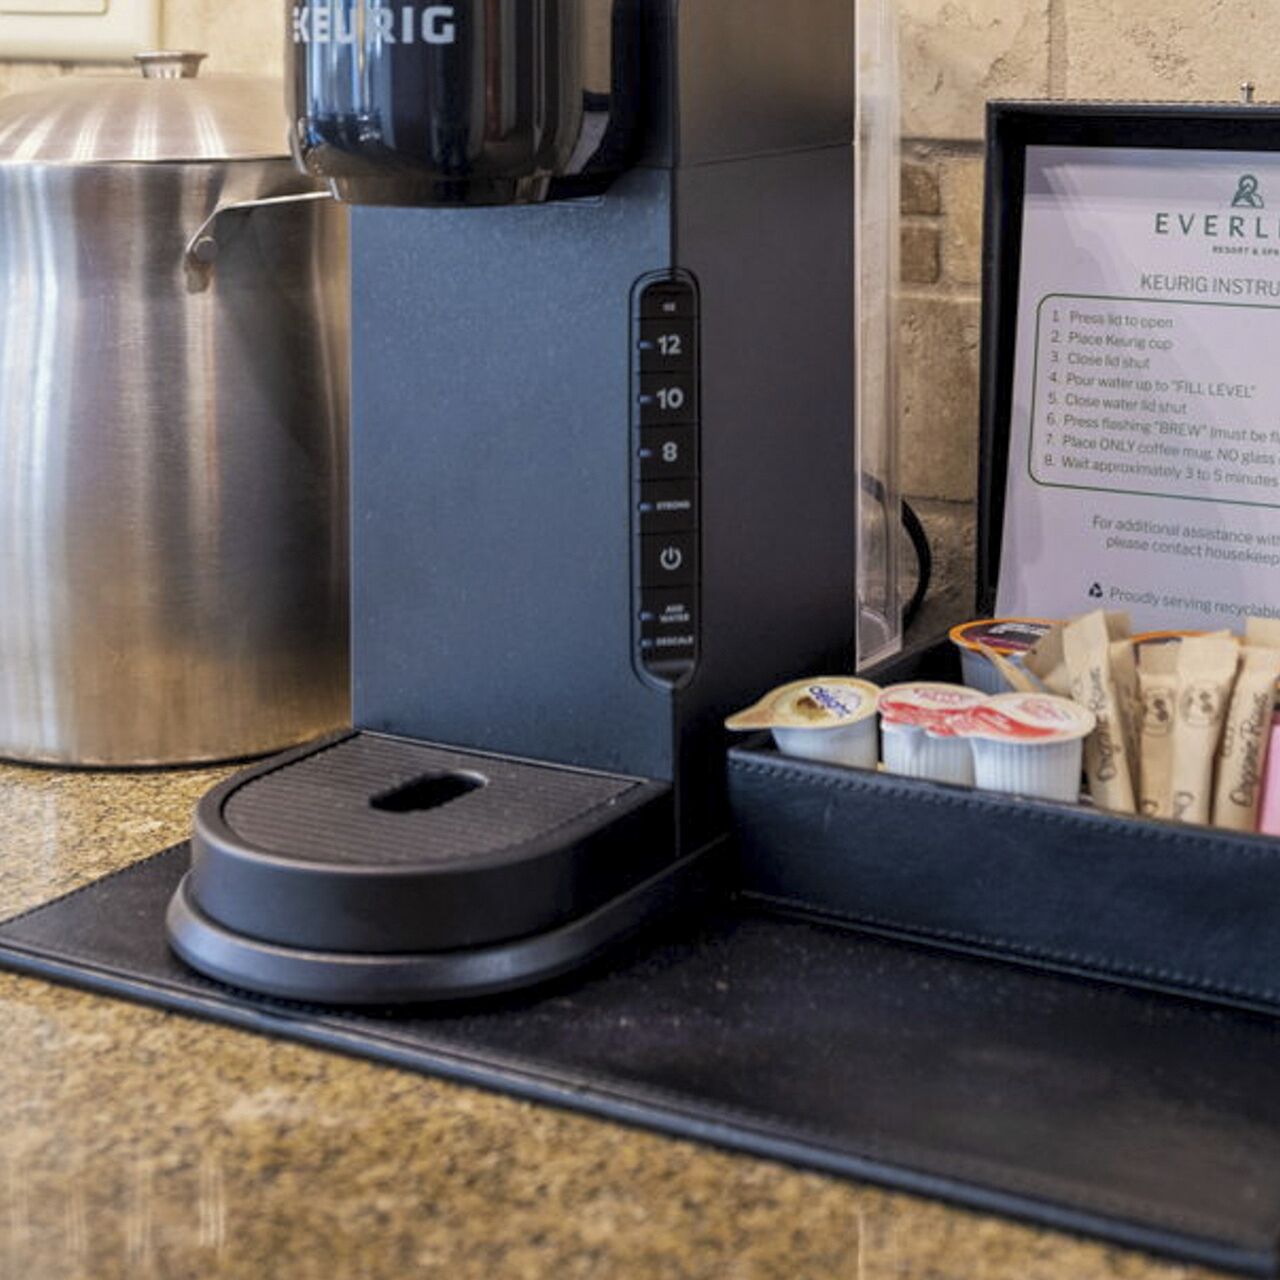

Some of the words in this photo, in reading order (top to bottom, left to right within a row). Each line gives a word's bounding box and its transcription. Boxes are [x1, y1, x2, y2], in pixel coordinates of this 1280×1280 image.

[294, 6, 455, 43] KEURIG
[1212, 246, 1249, 255] RESORT
[1140, 274, 1207, 293] KEURIG
[1070, 310, 1104, 325] Press
[1107, 313, 1121, 326] lid
[1125, 315, 1138, 327] to
[1140, 318, 1173, 329] open
[657, 334, 681, 355] 12
[1069, 331, 1103, 346] Place
[1106, 334, 1146, 351] Keurig
[1149, 339, 1174, 350] cup
[1068, 353, 1103, 367] Close
[1105, 355, 1119, 367] lid
[1122, 357, 1150, 369] shut
[1066, 373, 1094, 386] Pour
[1098, 377, 1133, 389] water
[1135, 381, 1152, 392] up
[1155, 380, 1168, 391] to
[656, 387, 684, 409] 10
[1066, 393, 1100, 407] Close
[1102, 398, 1137, 411] water
[1140, 399, 1155, 412] lid
[1158, 402, 1187, 414] shut
[1064, 414, 1098, 429] Press
[1101, 417, 1151, 435] flashing
[1154, 420, 1207, 438] "BREW"
[1250, 429, 1267, 442] be
[662, 442, 677, 462] 8
[1063, 434, 1097, 449] Place
[1099, 438, 1136, 453] ONLY
[1138, 443, 1180, 457] coffee
[1217, 447, 1239, 462] NO
[1241, 449, 1275, 466] glass
[1062, 455, 1089, 469] Wait
[1092, 459, 1182, 480] approximately
[1185, 466, 1194, 479] 3
[1197, 468, 1210, 481] to
[1213, 468, 1222, 482] 5
[1225, 472, 1279, 488] minutes
[656, 500, 691, 511] STRONG
[1092, 514, 1112, 530] For
[1115, 518, 1179, 536] additional
[1182, 526, 1253, 545] assistance
[1106, 536, 1149, 552] please
[1152, 541, 1202, 559] contact
[1110, 586, 1159, 608] Proudly
[1162, 595, 1211, 615] serving
[656, 635, 694, 647] DESCALE
